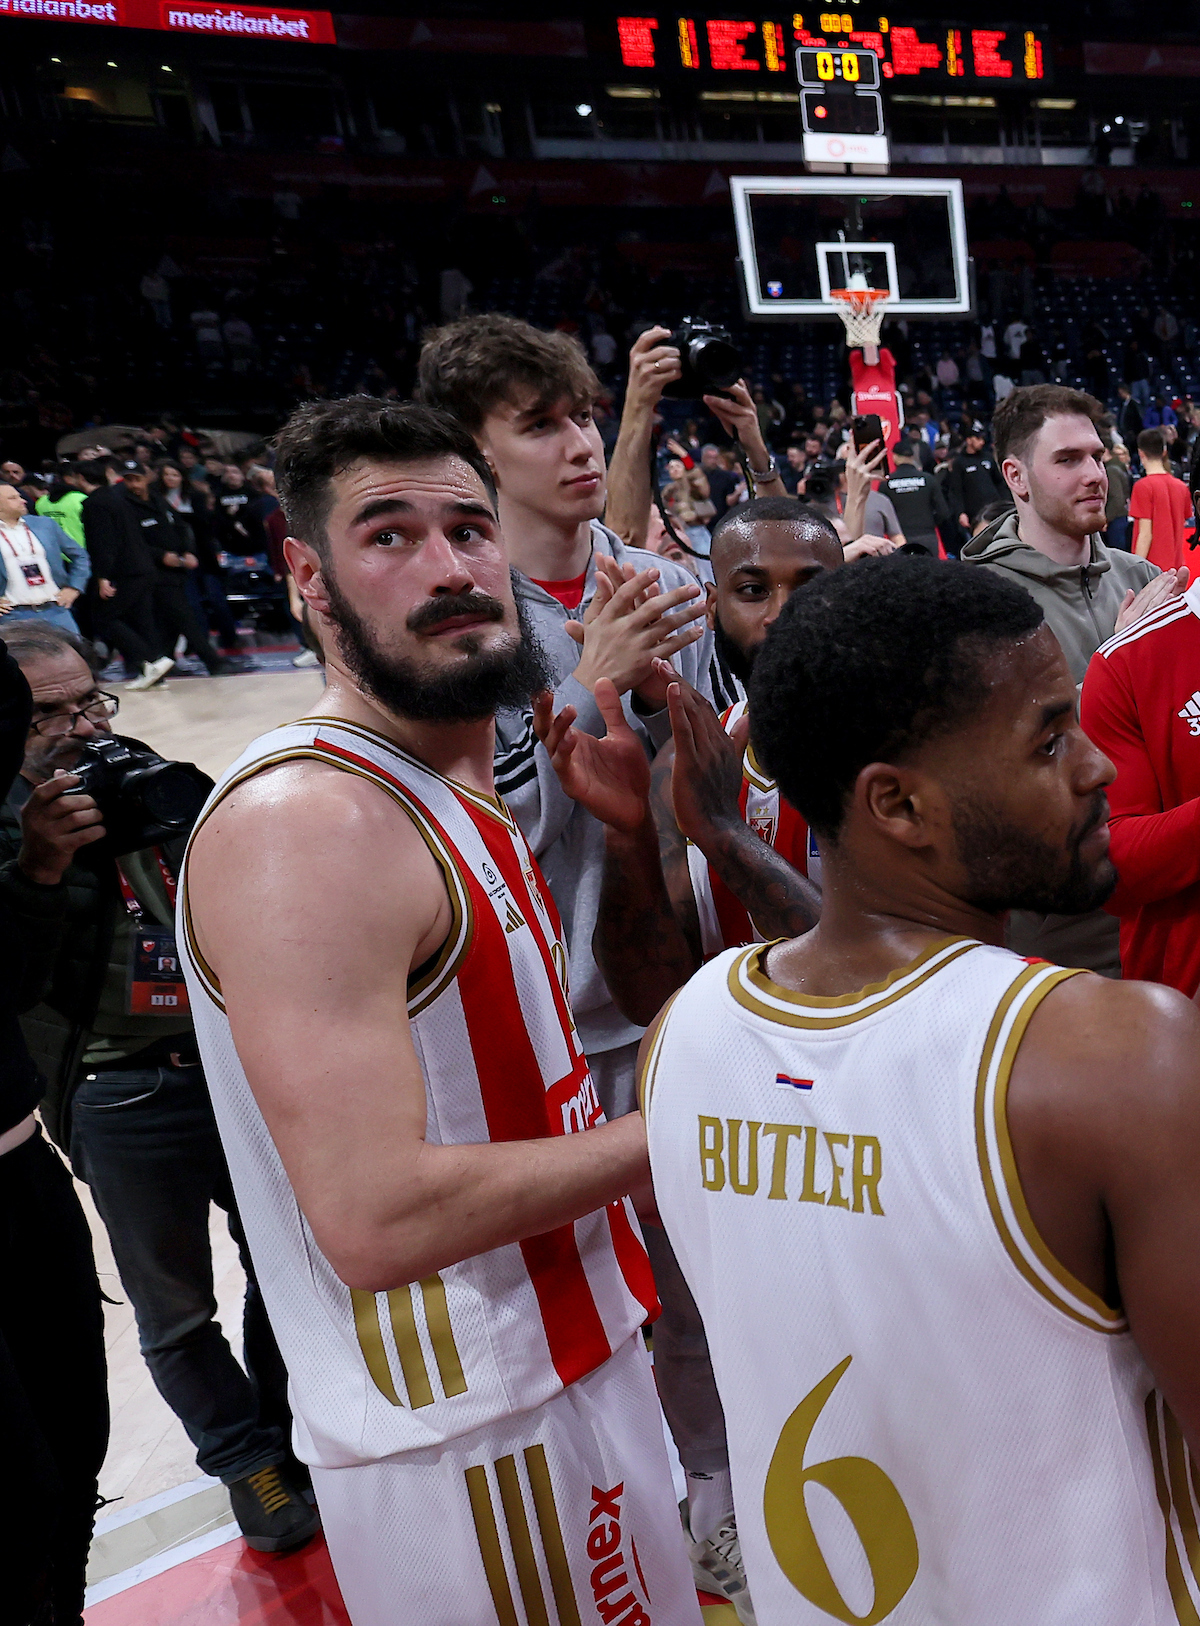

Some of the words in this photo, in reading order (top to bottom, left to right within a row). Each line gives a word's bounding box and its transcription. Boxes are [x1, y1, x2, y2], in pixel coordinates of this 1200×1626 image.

[168, 9, 309, 38] meridianbet
[698, 1115, 885, 1216] BUTLER
[763, 1354, 919, 1626] 6
